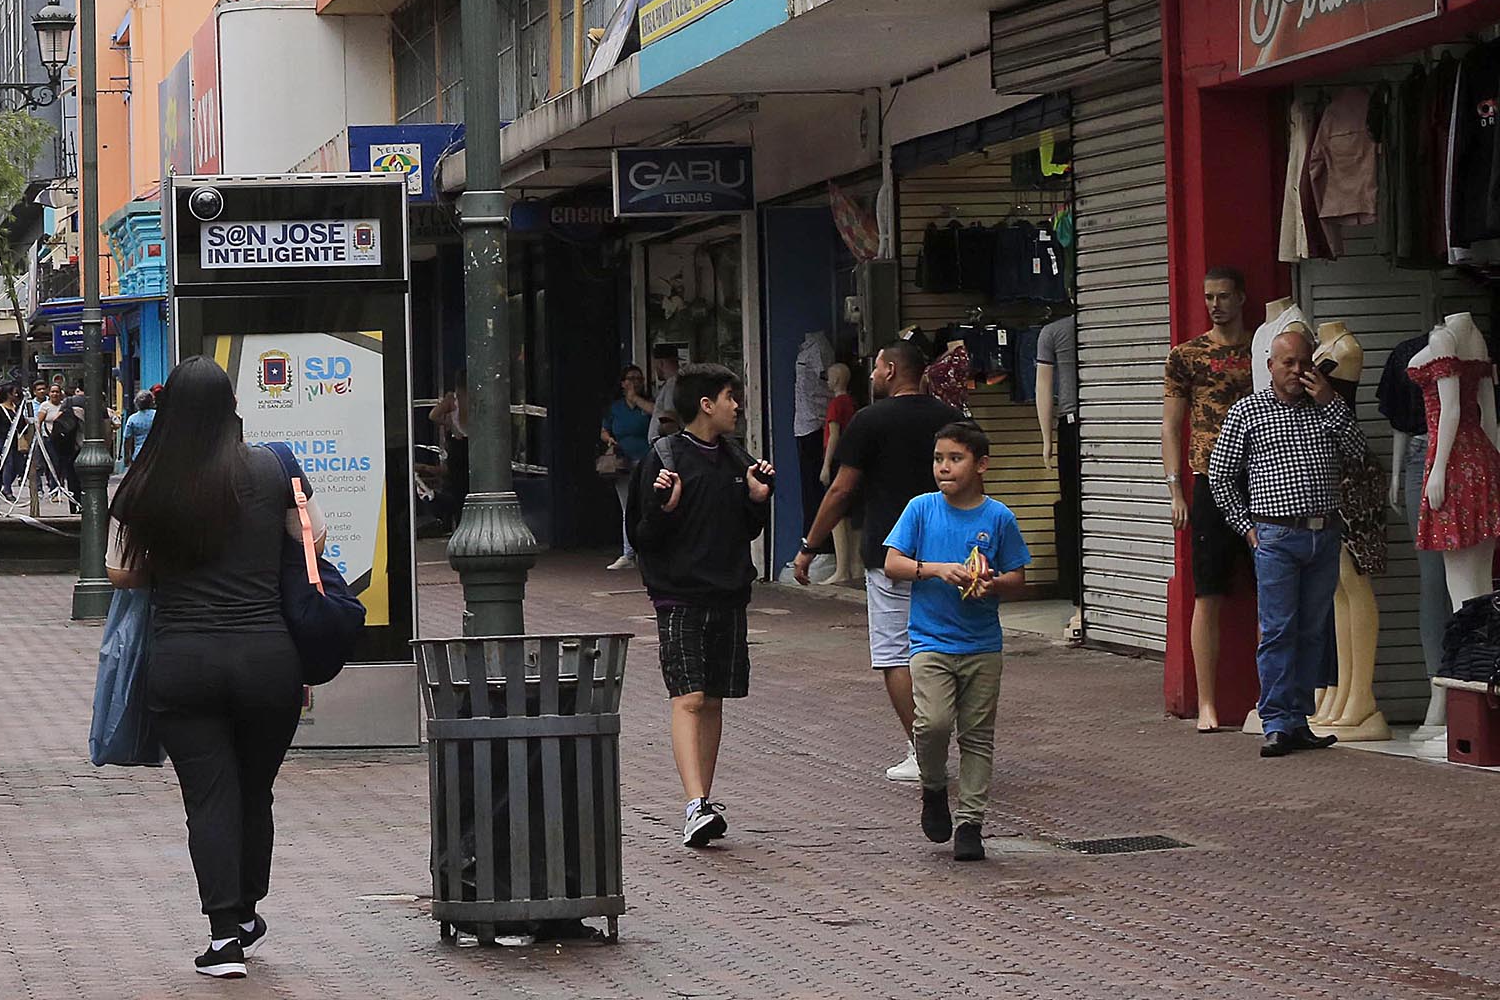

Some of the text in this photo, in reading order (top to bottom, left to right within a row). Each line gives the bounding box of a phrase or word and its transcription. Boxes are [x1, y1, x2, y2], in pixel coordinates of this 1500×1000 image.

[628, 159, 745, 190] GABU
[664, 192, 712, 204] TIENDAS
[207, 224, 267, 247] S@N
[207, 246, 346, 264] INTELIGENTE
[312, 440, 336, 455] DE
[328, 474, 354, 482] Centro
[328, 484, 366, 495] Municipal
